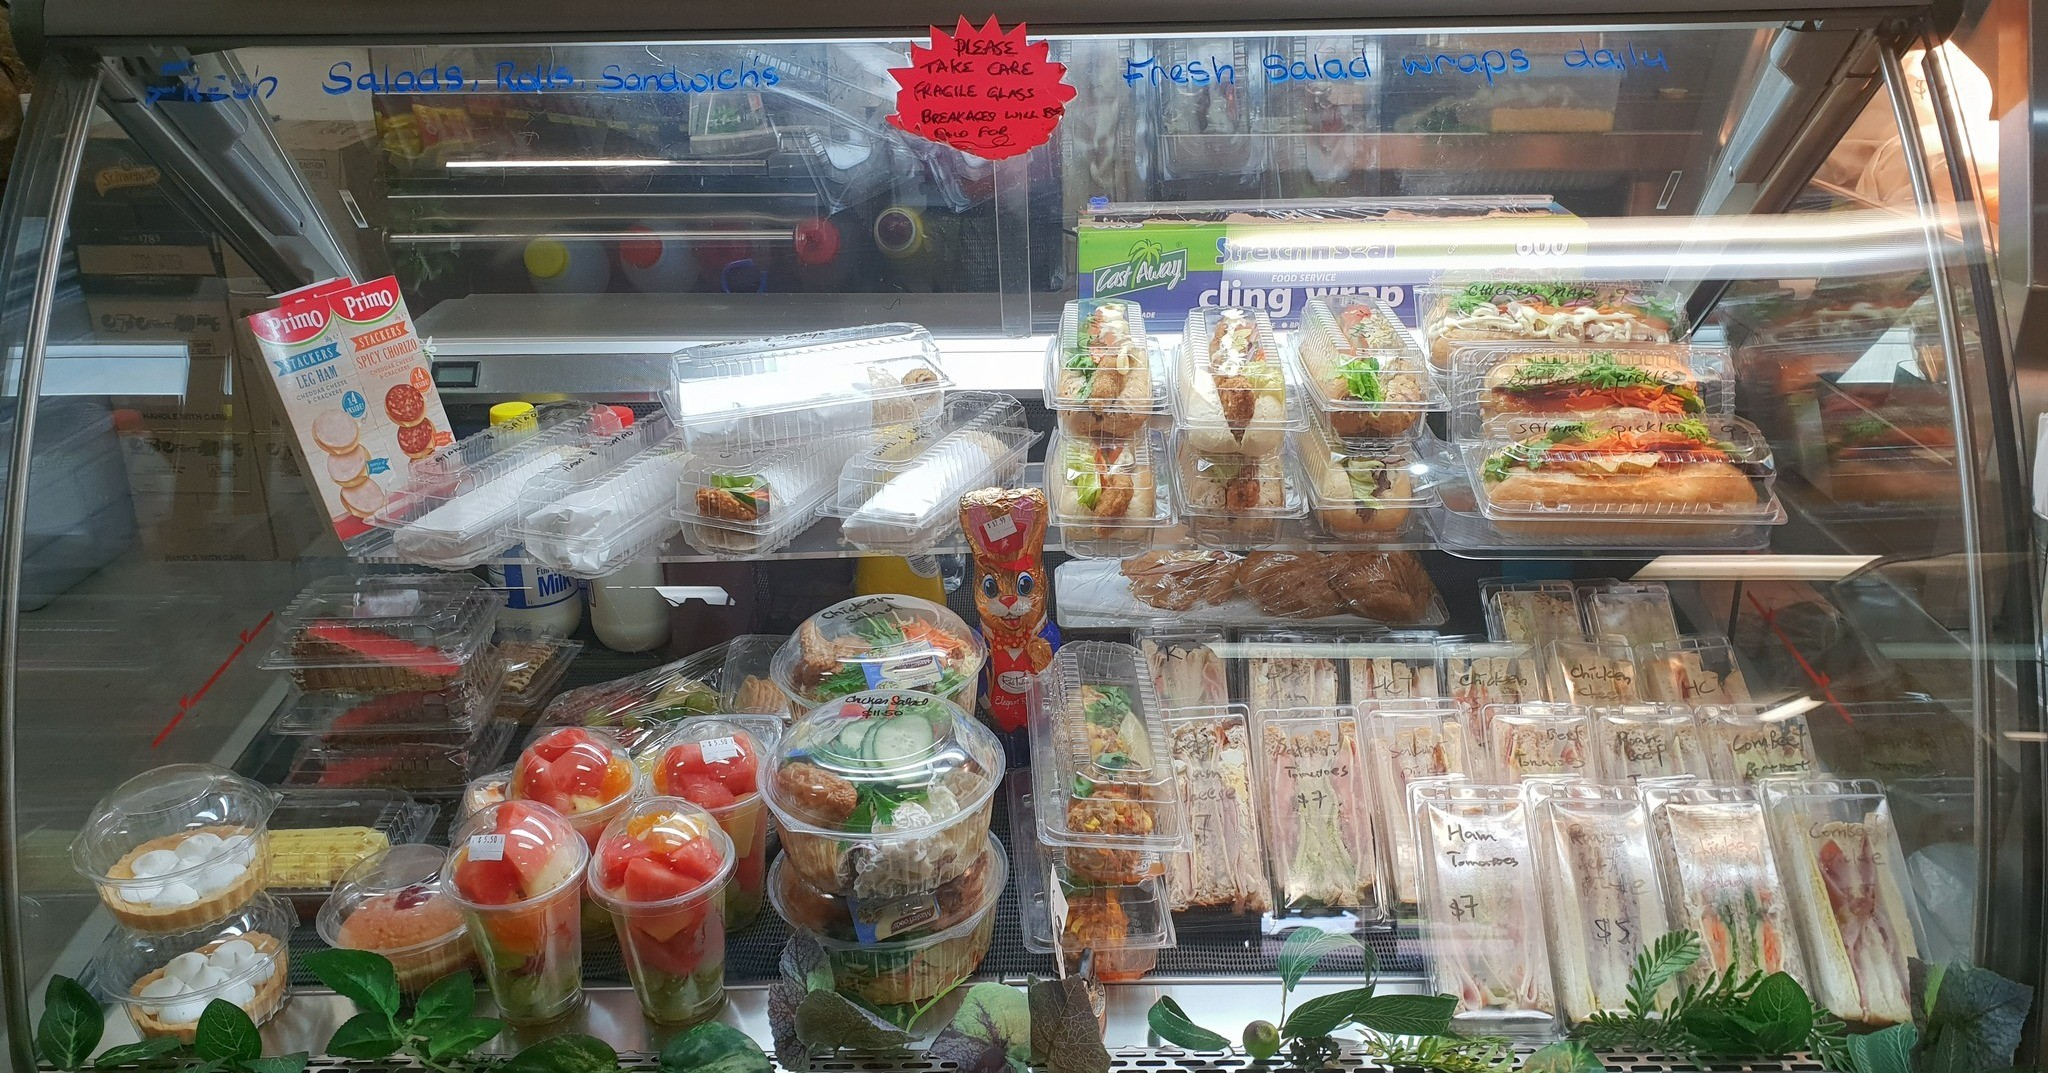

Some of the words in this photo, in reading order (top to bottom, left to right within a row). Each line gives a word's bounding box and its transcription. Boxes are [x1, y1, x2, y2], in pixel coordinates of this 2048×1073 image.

[953, 38, 1018, 57] PLEASE
[920, 58, 974, 74] TAKE
[987, 60, 1033, 76] CARE
[1123, 56, 1234, 88] Fresh
[1262, 49, 1372, 85] Salad
[1402, 48, 1531, 86] wraps
[1563, 39, 1670, 72] daily
[913, 80, 977, 101] FRAGILE
[986, 86, 1035, 101] GLASS
[1005, 110, 1039, 120] WILL
[1096, 265, 1133, 292] Cast
[1136, 259, 1183, 291] Away
[1271, 274, 1297, 283] FOOD
[1299, 273, 1337, 282] SERVICE
[343, 289, 394, 318] Primo
[1198, 279, 1292, 318] cling
[266, 309, 324, 340] Primo
[358, 325, 403, 348] STACKERS
[282, 346, 334, 372] STACKERS
[355, 351, 382, 370] SPICY
[382, 337, 418, 360] CHORIZO
[295, 371, 317, 390] LEG
[316, 364, 338, 383] HAM
[537, 573, 572, 598] Milk
[821, 596, 895, 620] Chicken
[845, 603, 903, 623] Salad
[1459, 672, 1528, 687] Chicken
[1570, 663, 1631, 685] Chicken
[890, 695, 929, 706] Salad
[1447, 824, 1497, 842] Ham
[1449, 894, 1479, 922] $7
